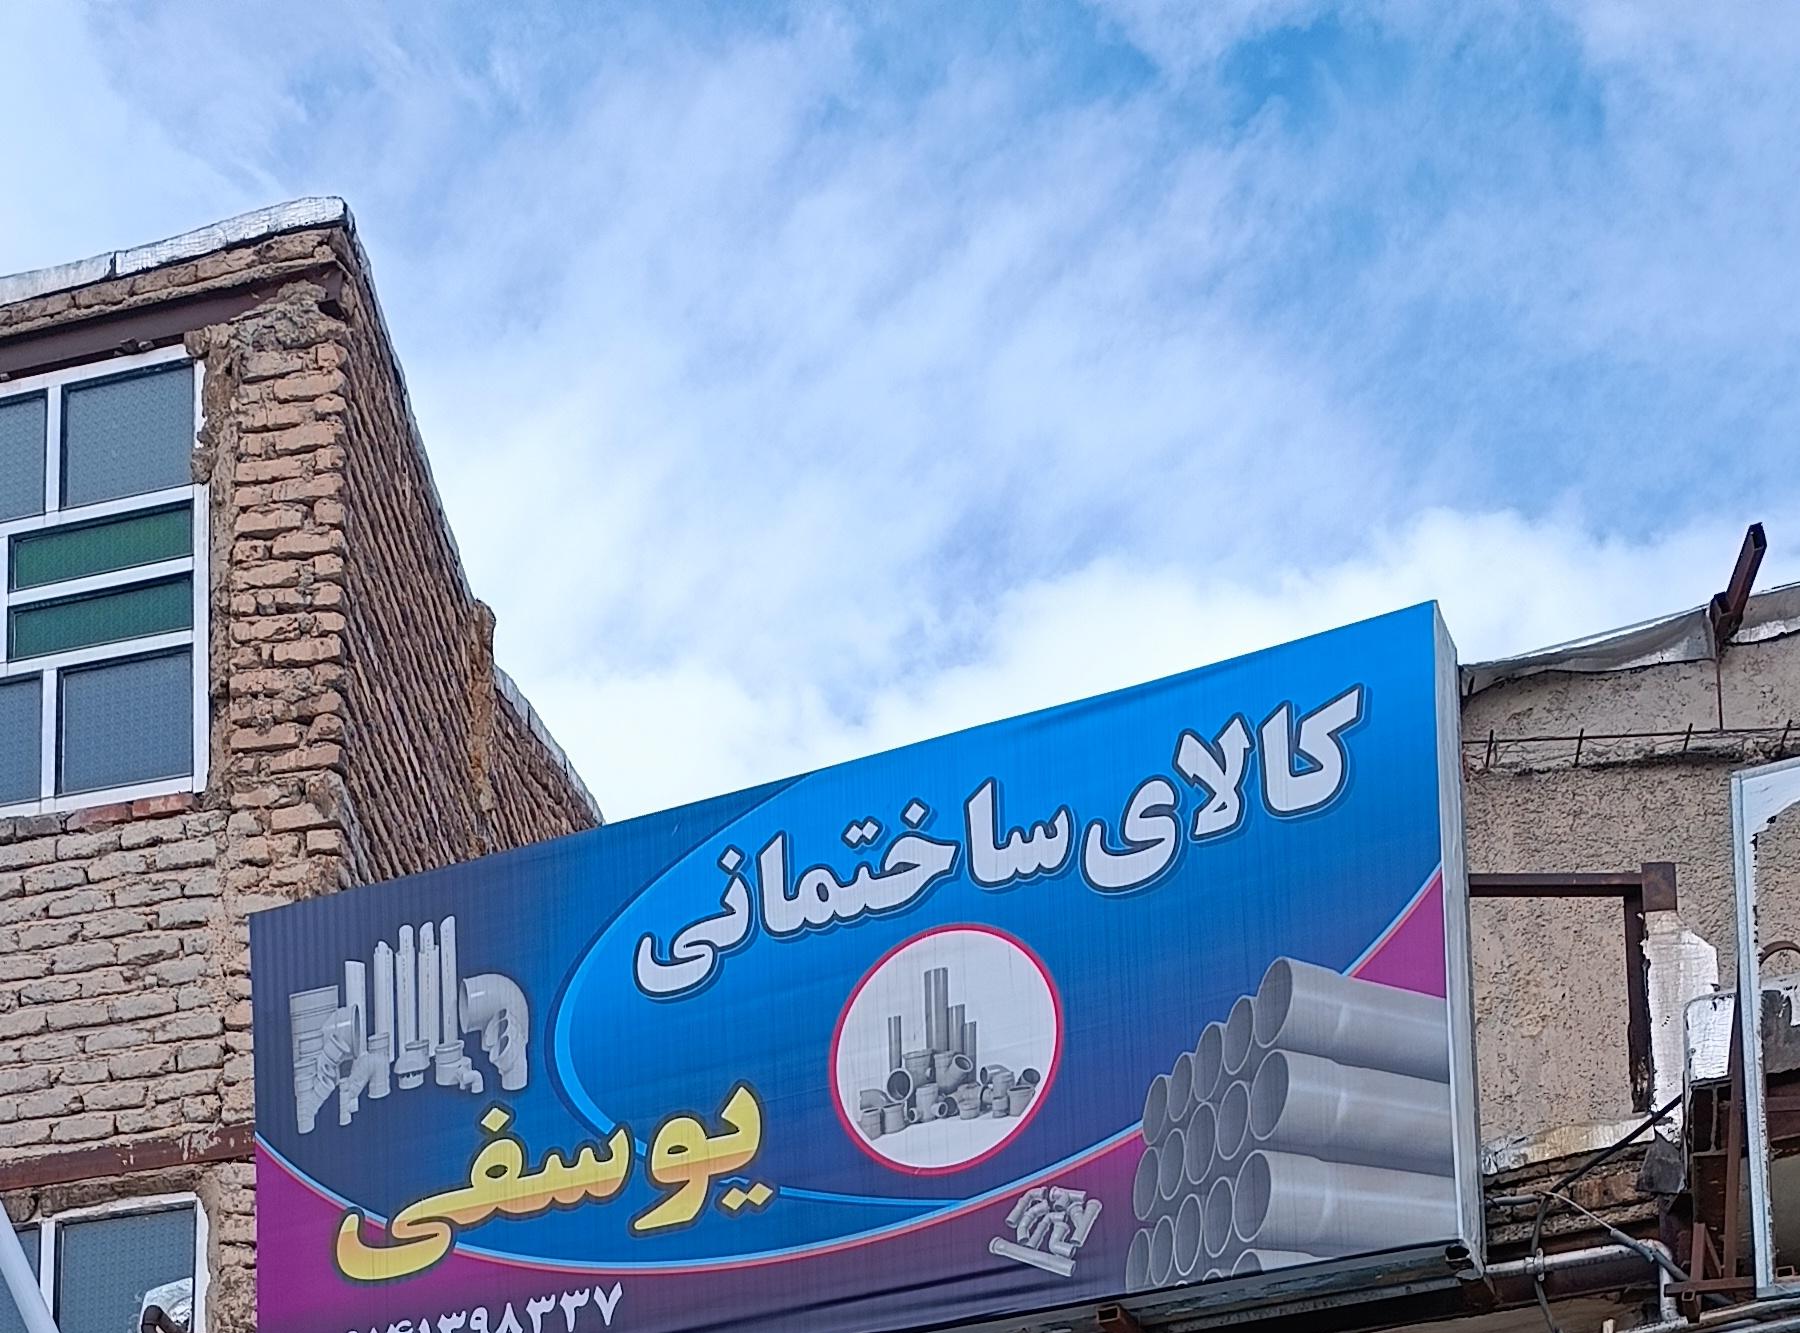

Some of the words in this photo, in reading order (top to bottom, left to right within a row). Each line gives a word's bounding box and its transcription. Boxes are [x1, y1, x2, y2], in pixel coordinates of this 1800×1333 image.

[633, 778, 1073, 1000] ساختمانی
[1081, 683, 1366, 893] کالای
[335, 1082, 780, 1282] یوسفی
